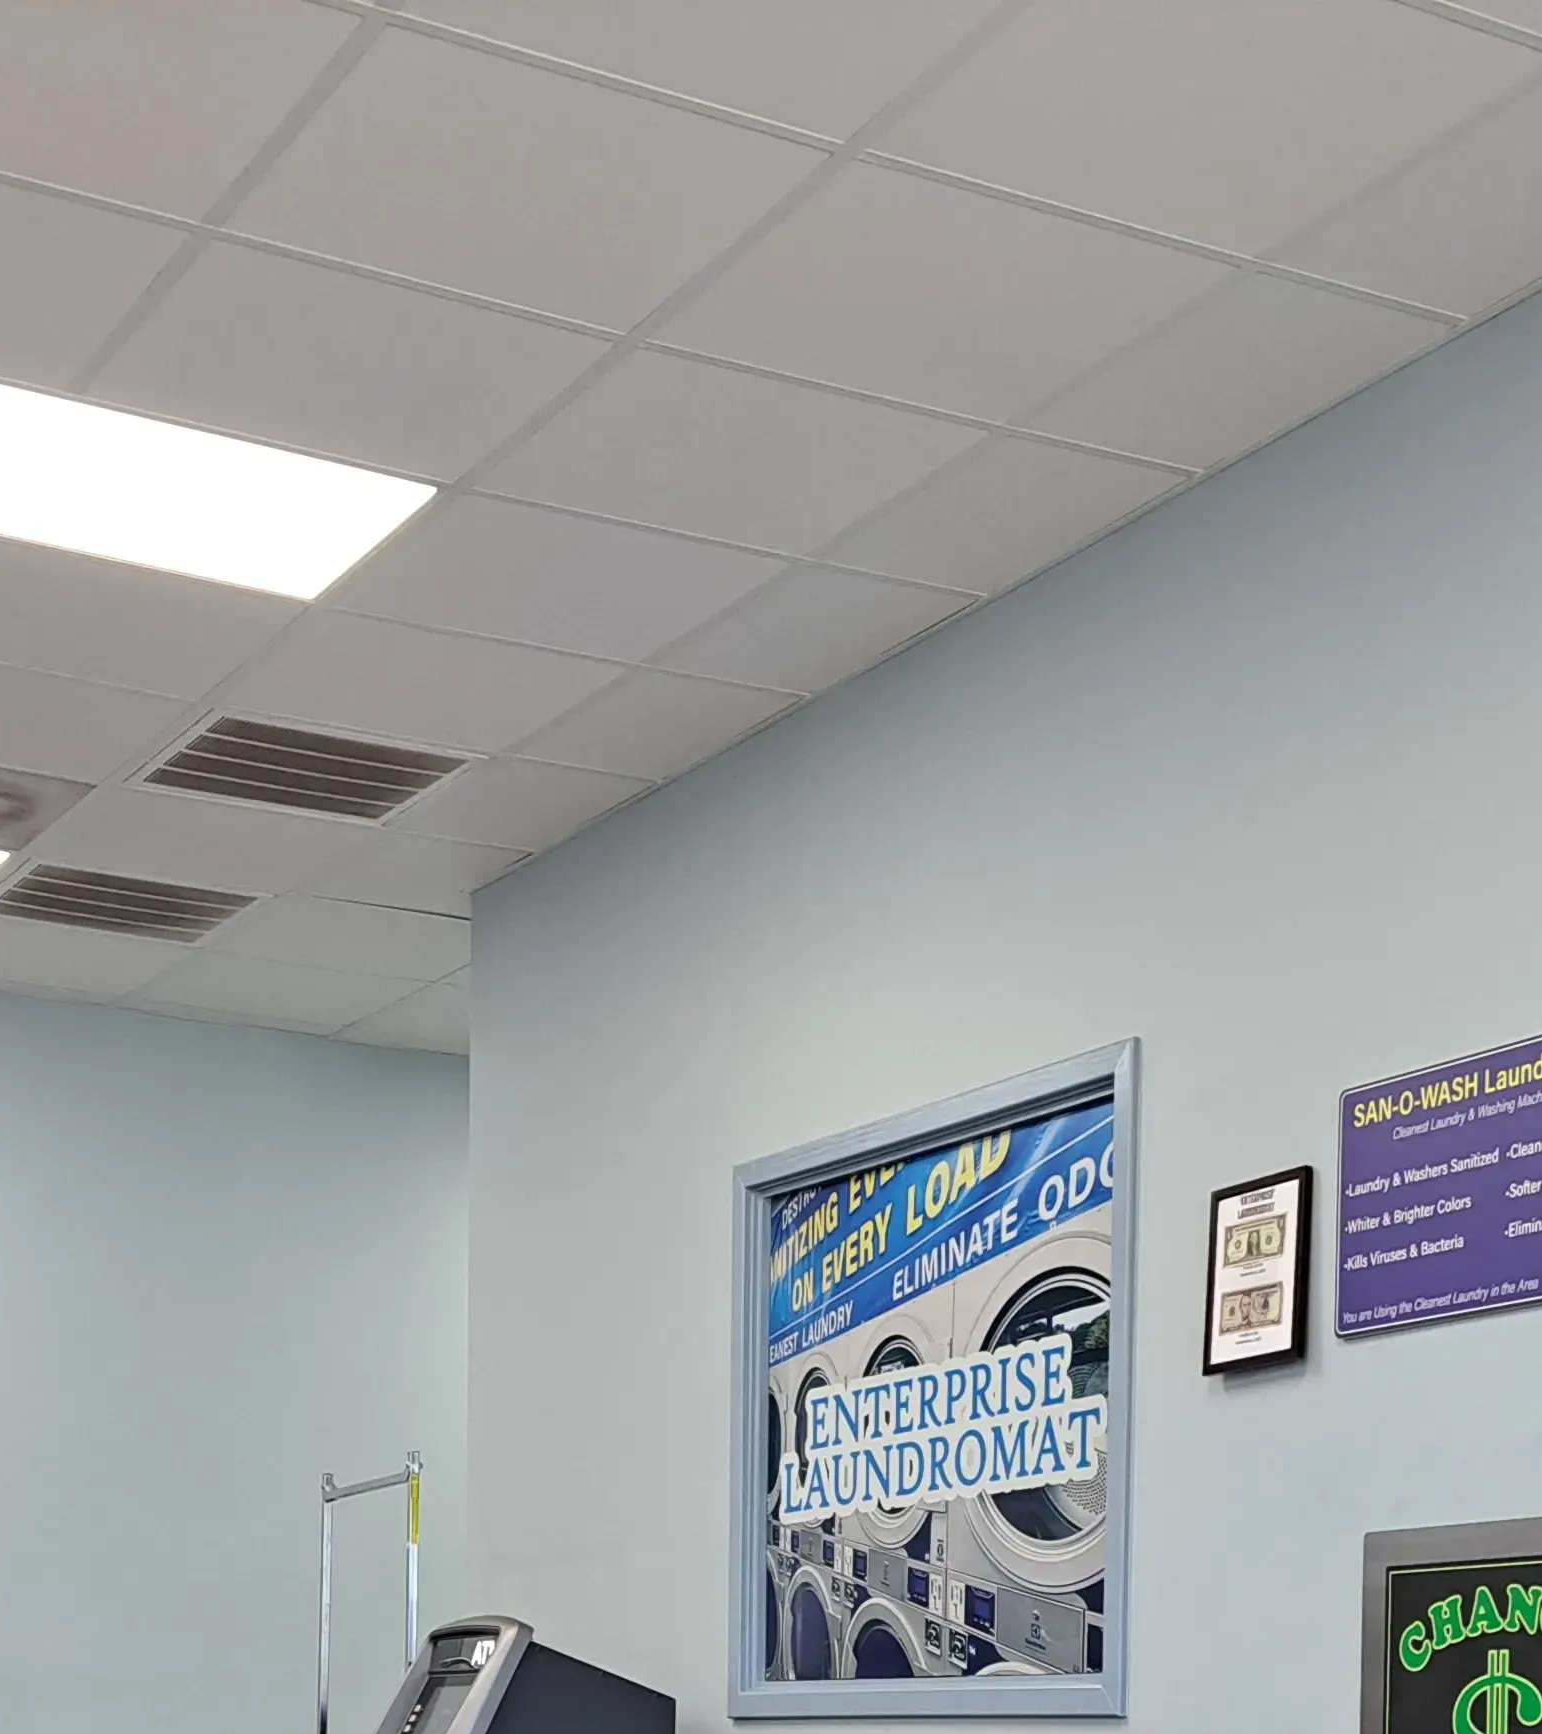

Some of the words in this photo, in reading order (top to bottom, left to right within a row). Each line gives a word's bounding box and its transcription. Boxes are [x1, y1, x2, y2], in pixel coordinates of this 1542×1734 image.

[1353, 1071, 1478, 1128] SAN-O-WASH
[1393, 1121, 1429, 1140] Cleanest
[1430, 1111, 1466, 1131] Laundry
[1468, 1107, 1476, 1122] &
[1478, 1097, 1515, 1118] Washing
[1392, 1171, 1401, 1187] &
[1404, 1163, 1448, 1184] Washers
[1450, 1147, 1499, 1173] Sanitized
[792, 1267, 814, 1311] ON
[821, 1202, 892, 1294] EVERY
[906, 1130, 1011, 1236] LOAD
[1382, 1212, 1391, 1226] &
[1394, 1202, 1435, 1225] Brighter
[1437, 1195, 1471, 1214] Colors
[802, 1299, 853, 1348] LAUNDRY
[892, 1197, 1019, 1301] ELIMINATE
[1370, 1247, 1407, 1266] Viruses
[1409, 1243, 1418, 1258] &
[1421, 1234, 1464, 1256] Bacteria
[1343, 1310, 1357, 1325] You
[1358, 1310, 1372, 1322] are
[1373, 1305, 1397, 1320] Using
[1399, 1301, 1412, 1314] the
[1414, 1293, 1452, 1311] Cleanest
[1452, 1286, 1490, 1304] Laundry
[1491, 1283, 1500, 1297] in
[1501, 1281, 1516, 1295] the
[1517, 1278, 1540, 1292] Area
[809, 1345, 1067, 1450] ENTERPRISE
[783, 1407, 1102, 1515] LAUNDROMAT
